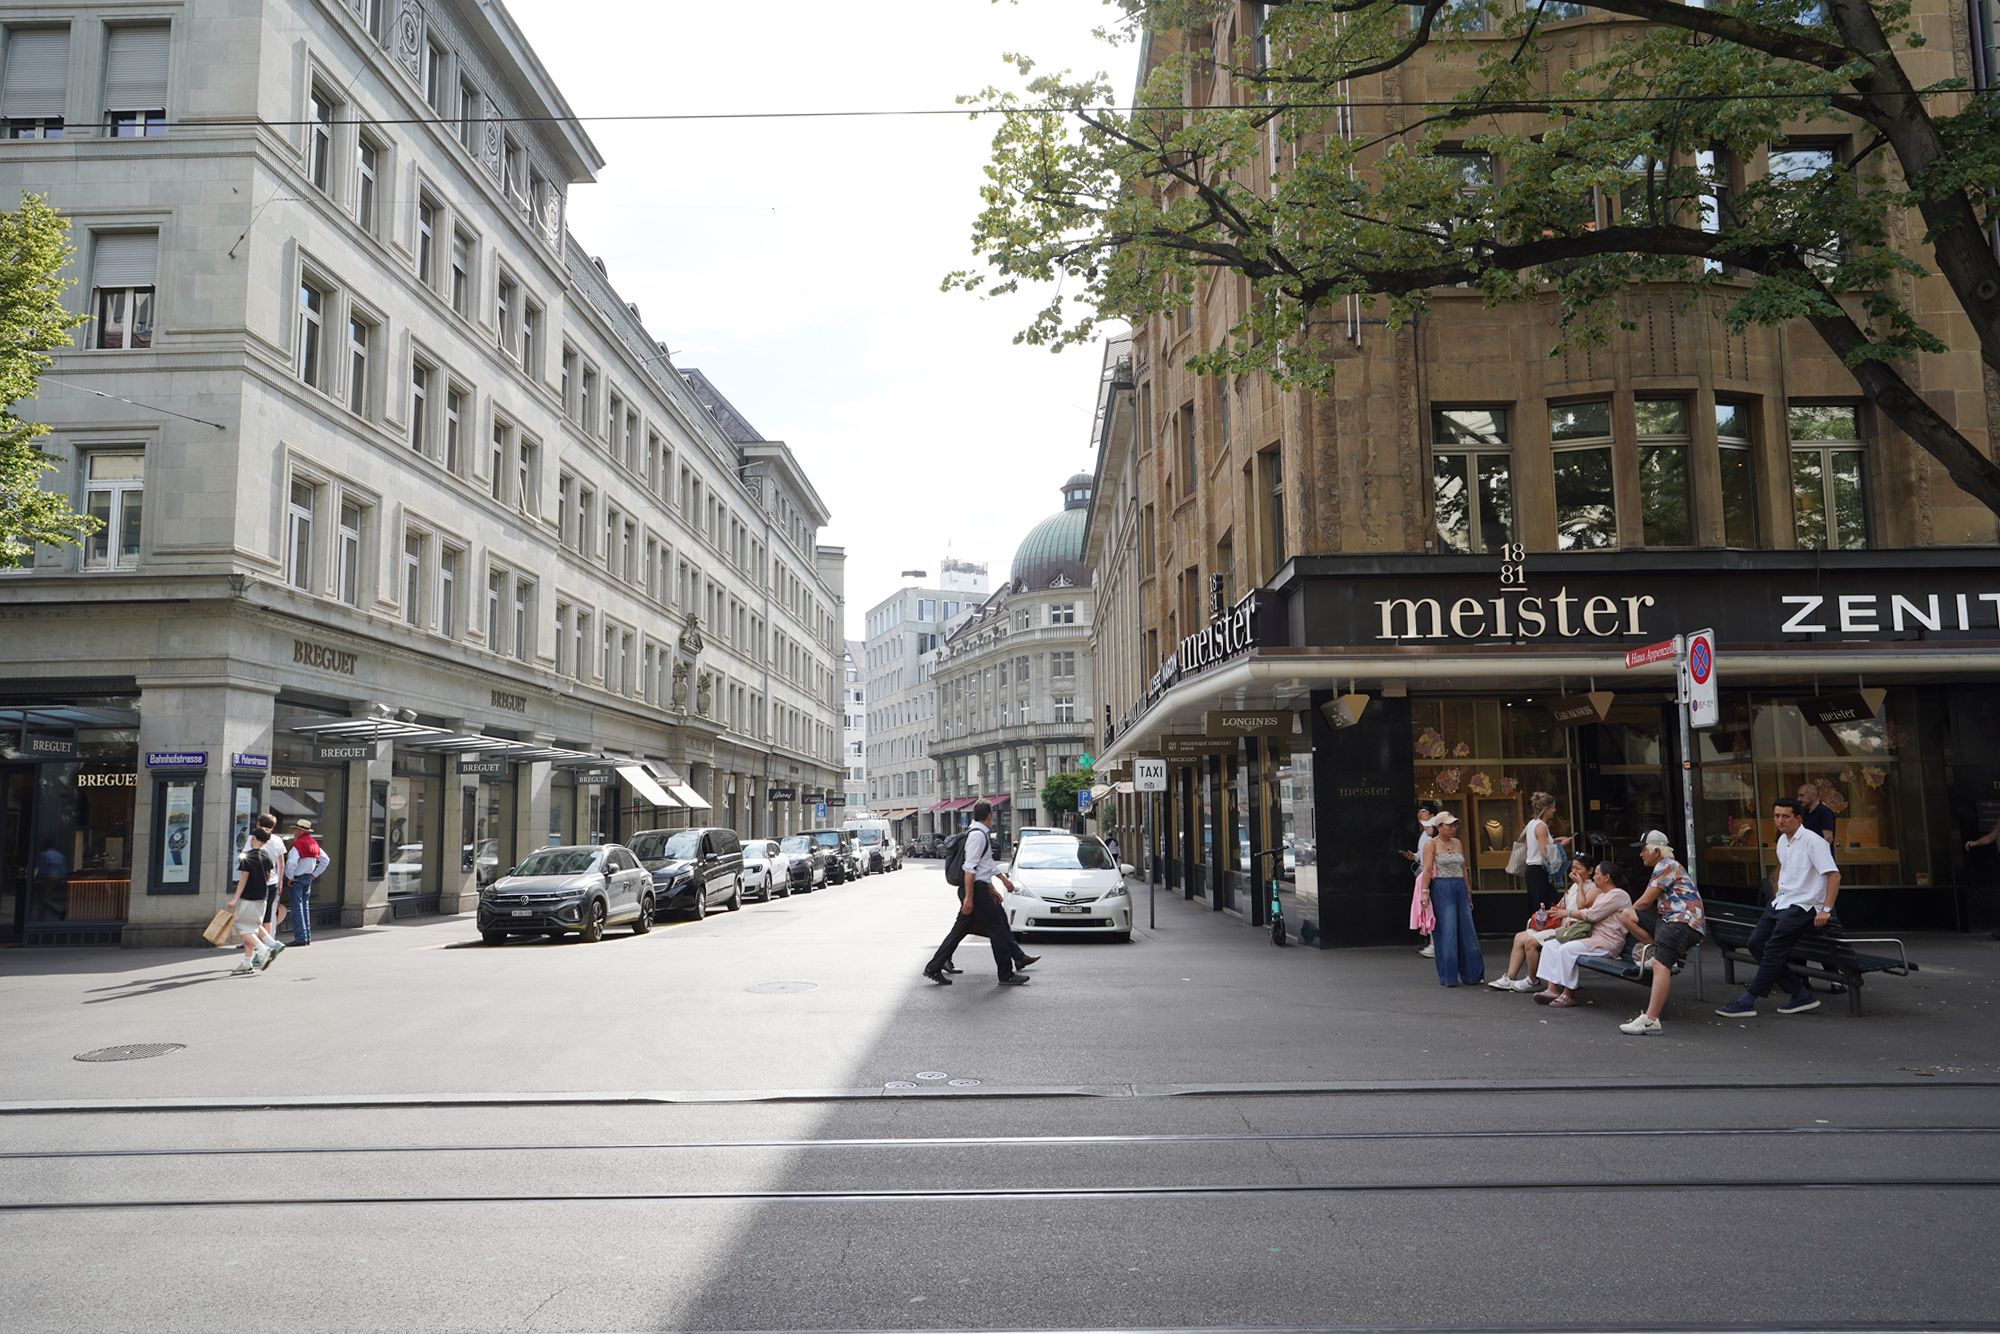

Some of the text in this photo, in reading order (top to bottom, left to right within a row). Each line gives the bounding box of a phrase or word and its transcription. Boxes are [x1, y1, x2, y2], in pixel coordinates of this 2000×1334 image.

[1500, 542, 1526, 562] 18
[1500, 564, 1526, 584] 81
[1374, 586, 1655, 639] meister
[1180, 600, 1255, 673] meister
[293, 639, 358, 675] BREGUET
[1631, 652, 1646, 665] Haus
[491, 689, 527, 714] BREGUET
[1222, 717, 1278, 726] LONGINES
[1819, 708, 1856, 722] meister
[33, 740, 72, 753] BREGUET
[321, 748, 367, 758] BREGUET
[149, 754, 203, 764] Bahnhofstrasse
[463, 763, 500, 772] BREGUET
[1139, 766, 1163, 778] TAXI
[579, 775, 609, 783] BREGUET
[1082, 791, 1088, 801] P
[1339, 787, 1390, 797] meister
